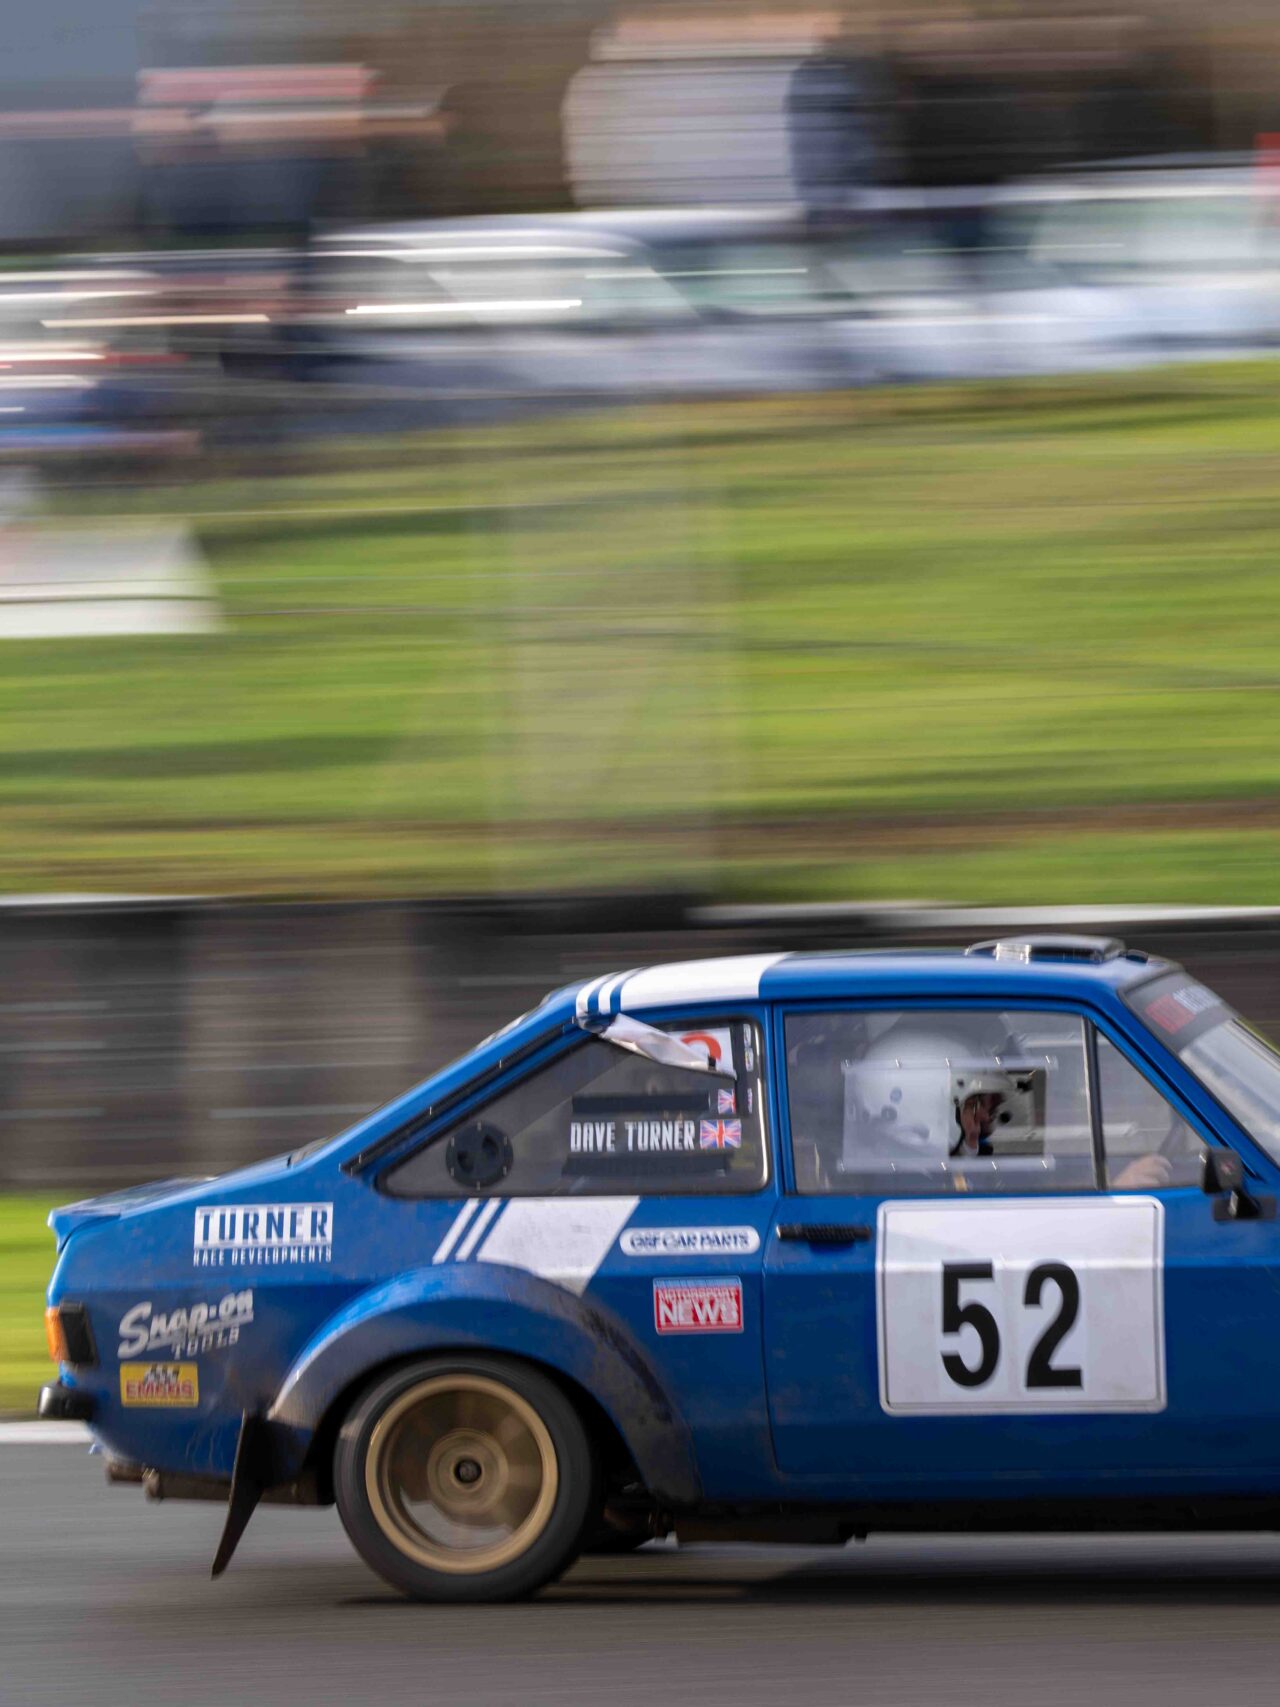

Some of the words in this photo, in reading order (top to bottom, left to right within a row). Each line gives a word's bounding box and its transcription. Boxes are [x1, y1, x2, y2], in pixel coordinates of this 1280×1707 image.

[570, 1121, 615, 1152] DAVE
[624, 1120, 695, 1151] TURNER
[199, 1208, 329, 1243] TURNER
[662, 1230, 698, 1249] CAR
[700, 1229, 749, 1248] PARTS
[193, 1247, 225, 1267] RACE
[231, 1245, 332, 1266] DEVELOPMENTS
[659, 1299, 739, 1326] NEWS
[941, 1260, 1083, 1388] 52
